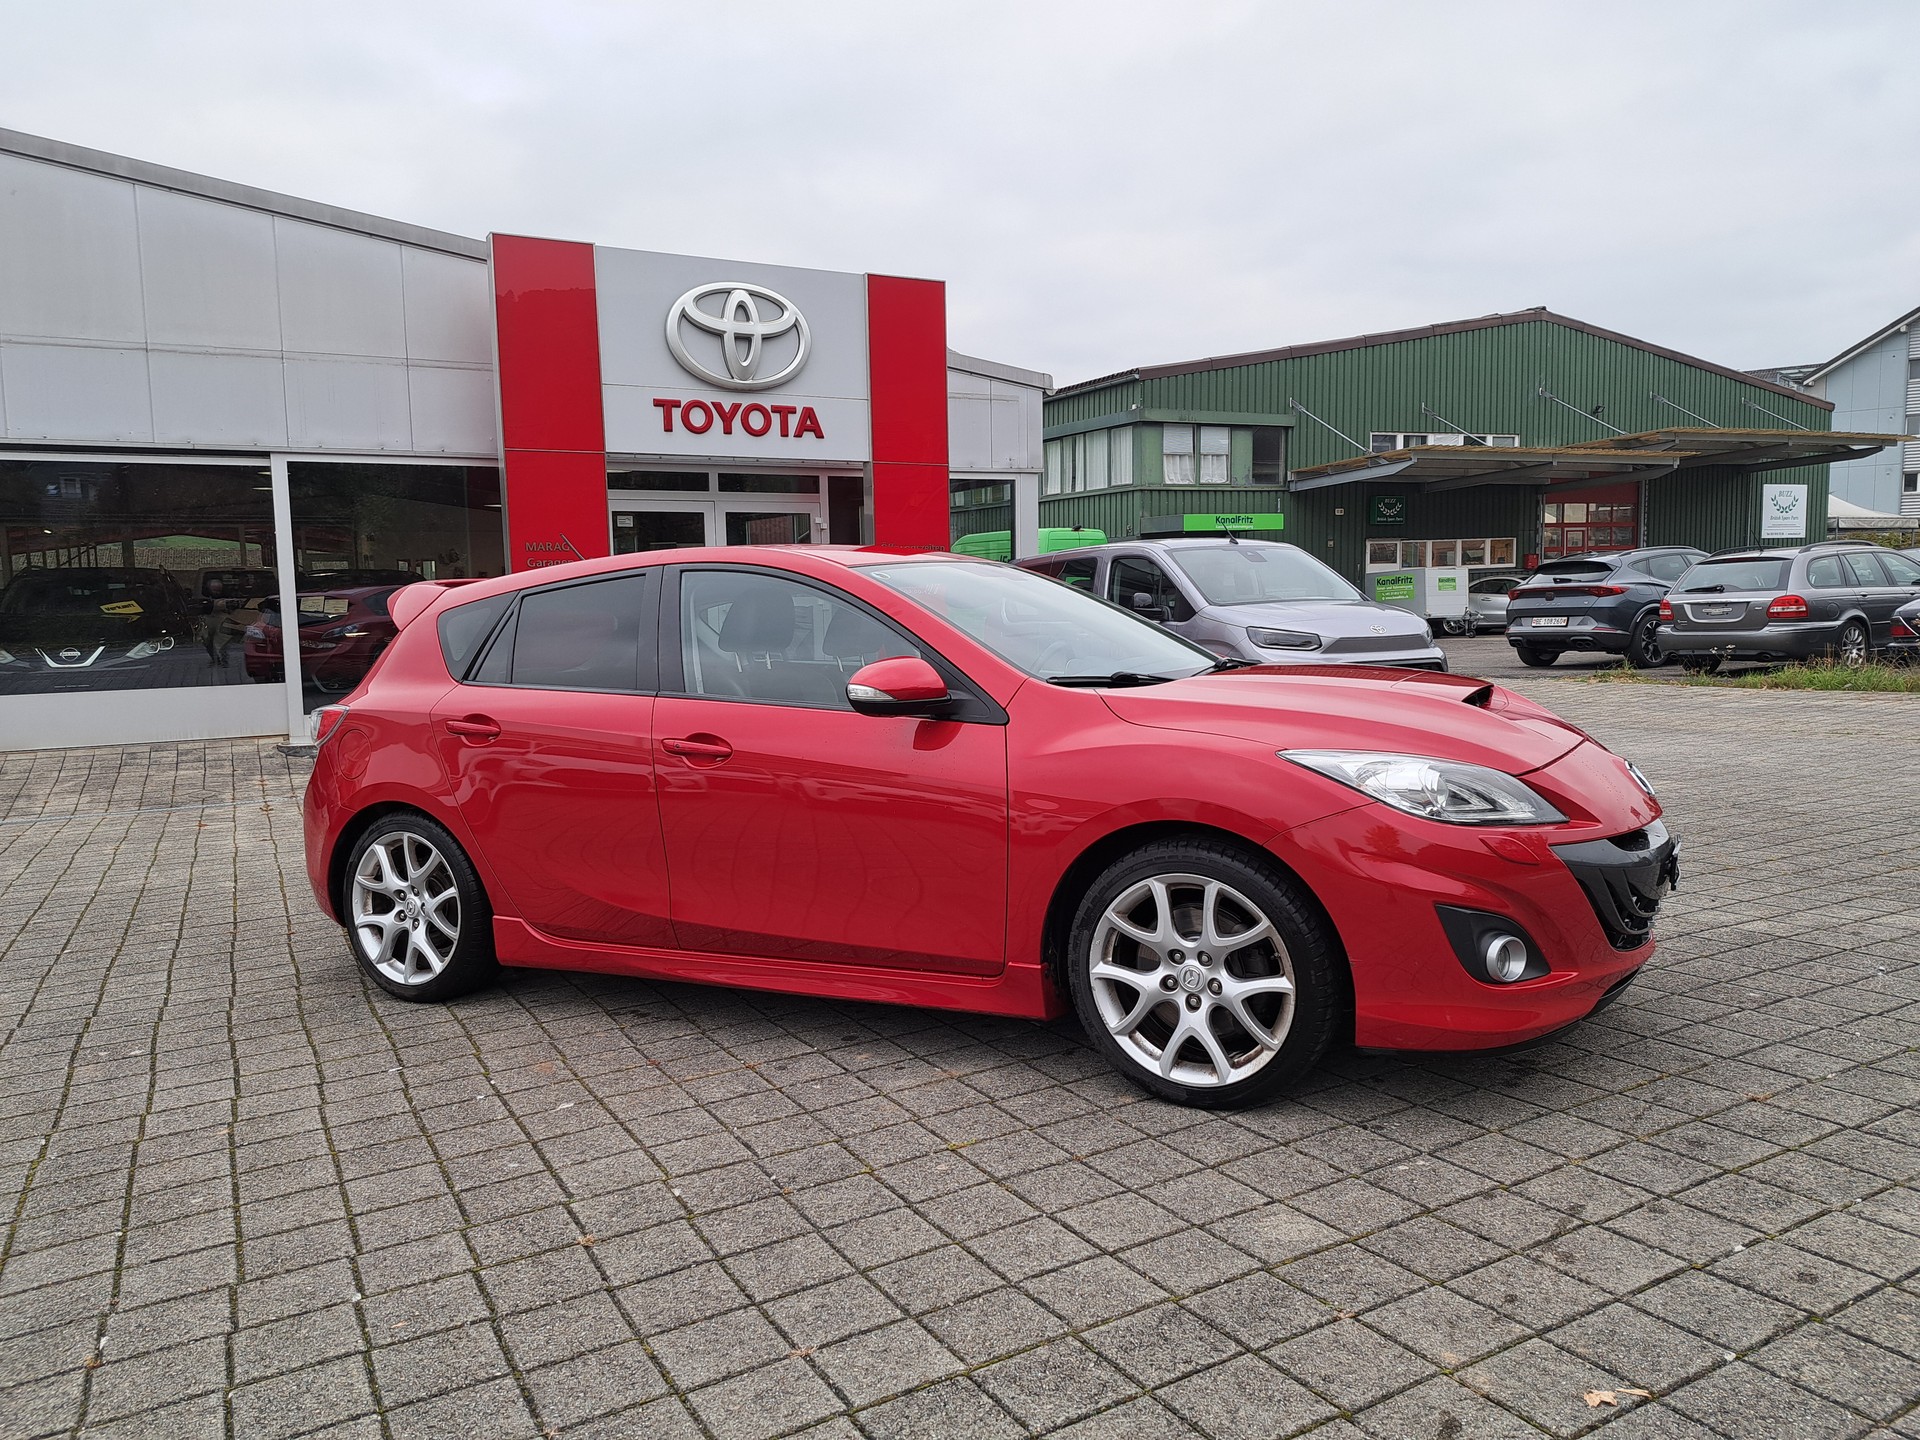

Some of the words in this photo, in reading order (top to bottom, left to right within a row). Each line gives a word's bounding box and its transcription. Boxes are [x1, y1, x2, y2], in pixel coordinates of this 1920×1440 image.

[653, 398, 825, 439] TOYOTA
[1215, 515, 1254, 524] KanalFritz
[525, 541, 570, 552] MARAG
[1376, 575, 1413, 586] KanalFritz
